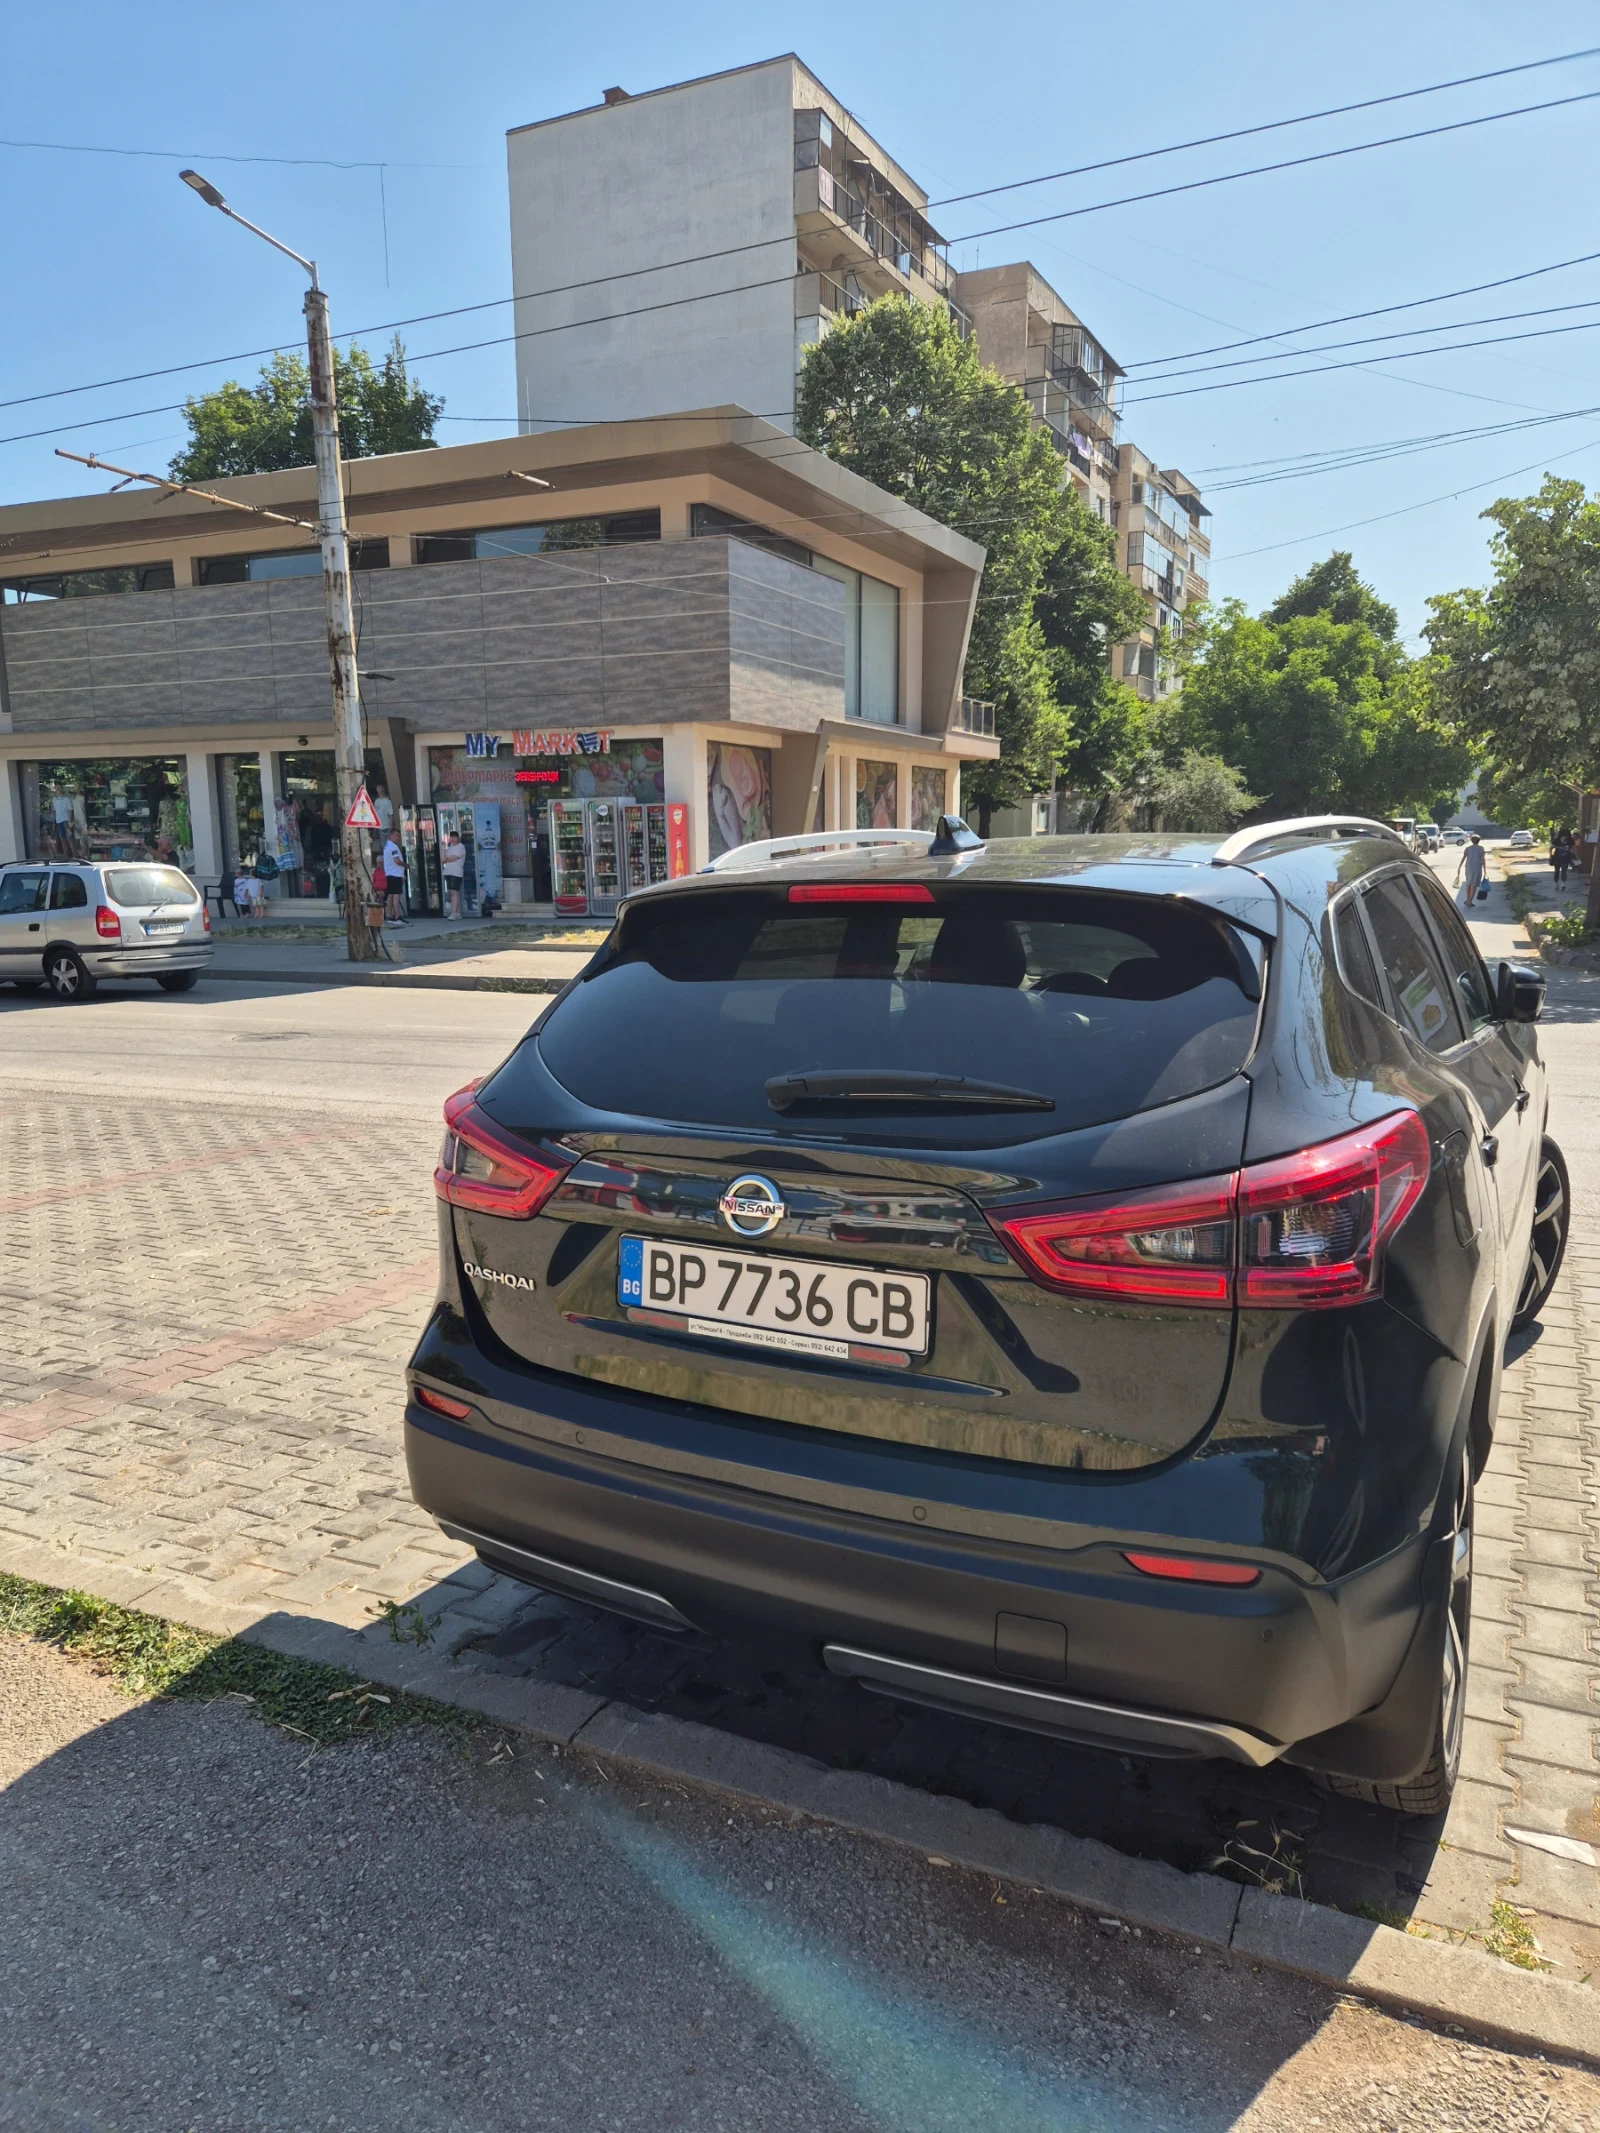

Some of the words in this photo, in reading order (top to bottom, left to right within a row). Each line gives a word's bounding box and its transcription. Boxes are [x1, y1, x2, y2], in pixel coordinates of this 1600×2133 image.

[440, 769, 515, 784] СУПЕРМАРКЕ
[725, 1200, 776, 1215] NISSAN
[464, 1262, 535, 1291] QASHQAI
[622, 1278, 641, 1296] BG
[717, 1259, 834, 1327] 7736
